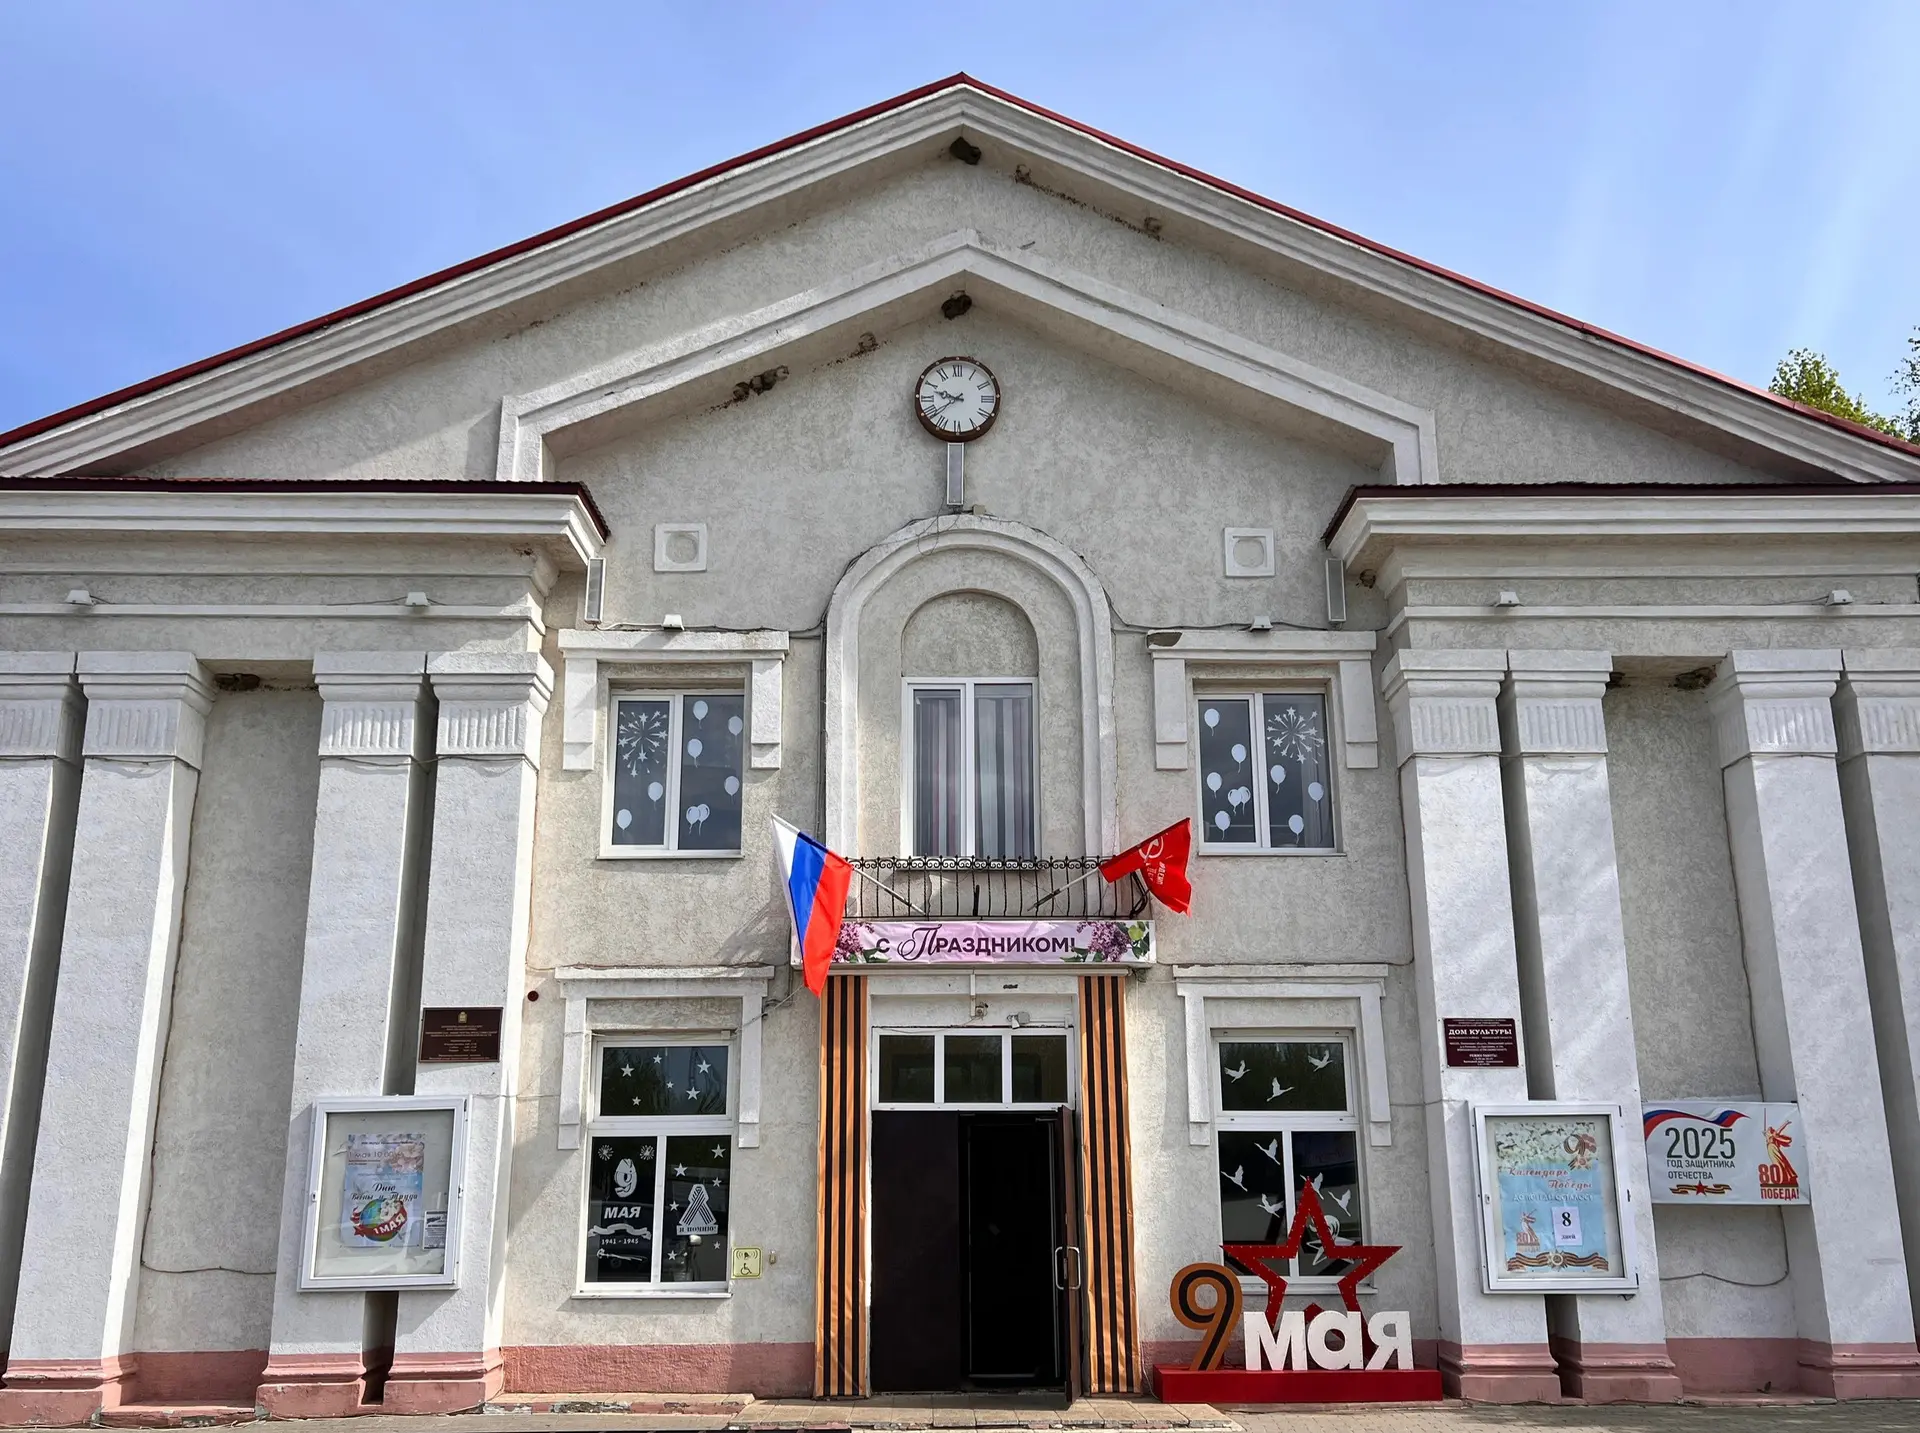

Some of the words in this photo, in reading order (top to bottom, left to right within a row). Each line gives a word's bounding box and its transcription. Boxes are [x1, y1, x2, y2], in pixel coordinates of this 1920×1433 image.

[1665, 1127, 1736, 1159] 2025
[1667, 1160, 1684, 1168] ГОД
[1684, 1160, 1735, 1169] ЗАЩИТНИКА
[614, 1158, 638, 1198] 9
[1508, 1167, 1569, 1179] Календарь
[1668, 1170, 1714, 1180] ОТЕЧЕСТВА
[1758, 1164, 1783, 1185] 80
[371, 1182, 397, 1192] Дню
[1548, 1178, 1592, 1191] Победы
[1761, 1188, 1800, 1200] ПОБЕДА!
[603, 1206, 642, 1220] МАЯ
[1561, 1211, 1572, 1227] 8
[379, 1213, 406, 1234] МАЯ
[601, 1238, 616, 1246] 1941
[1169, 1262, 1243, 1371] 9
